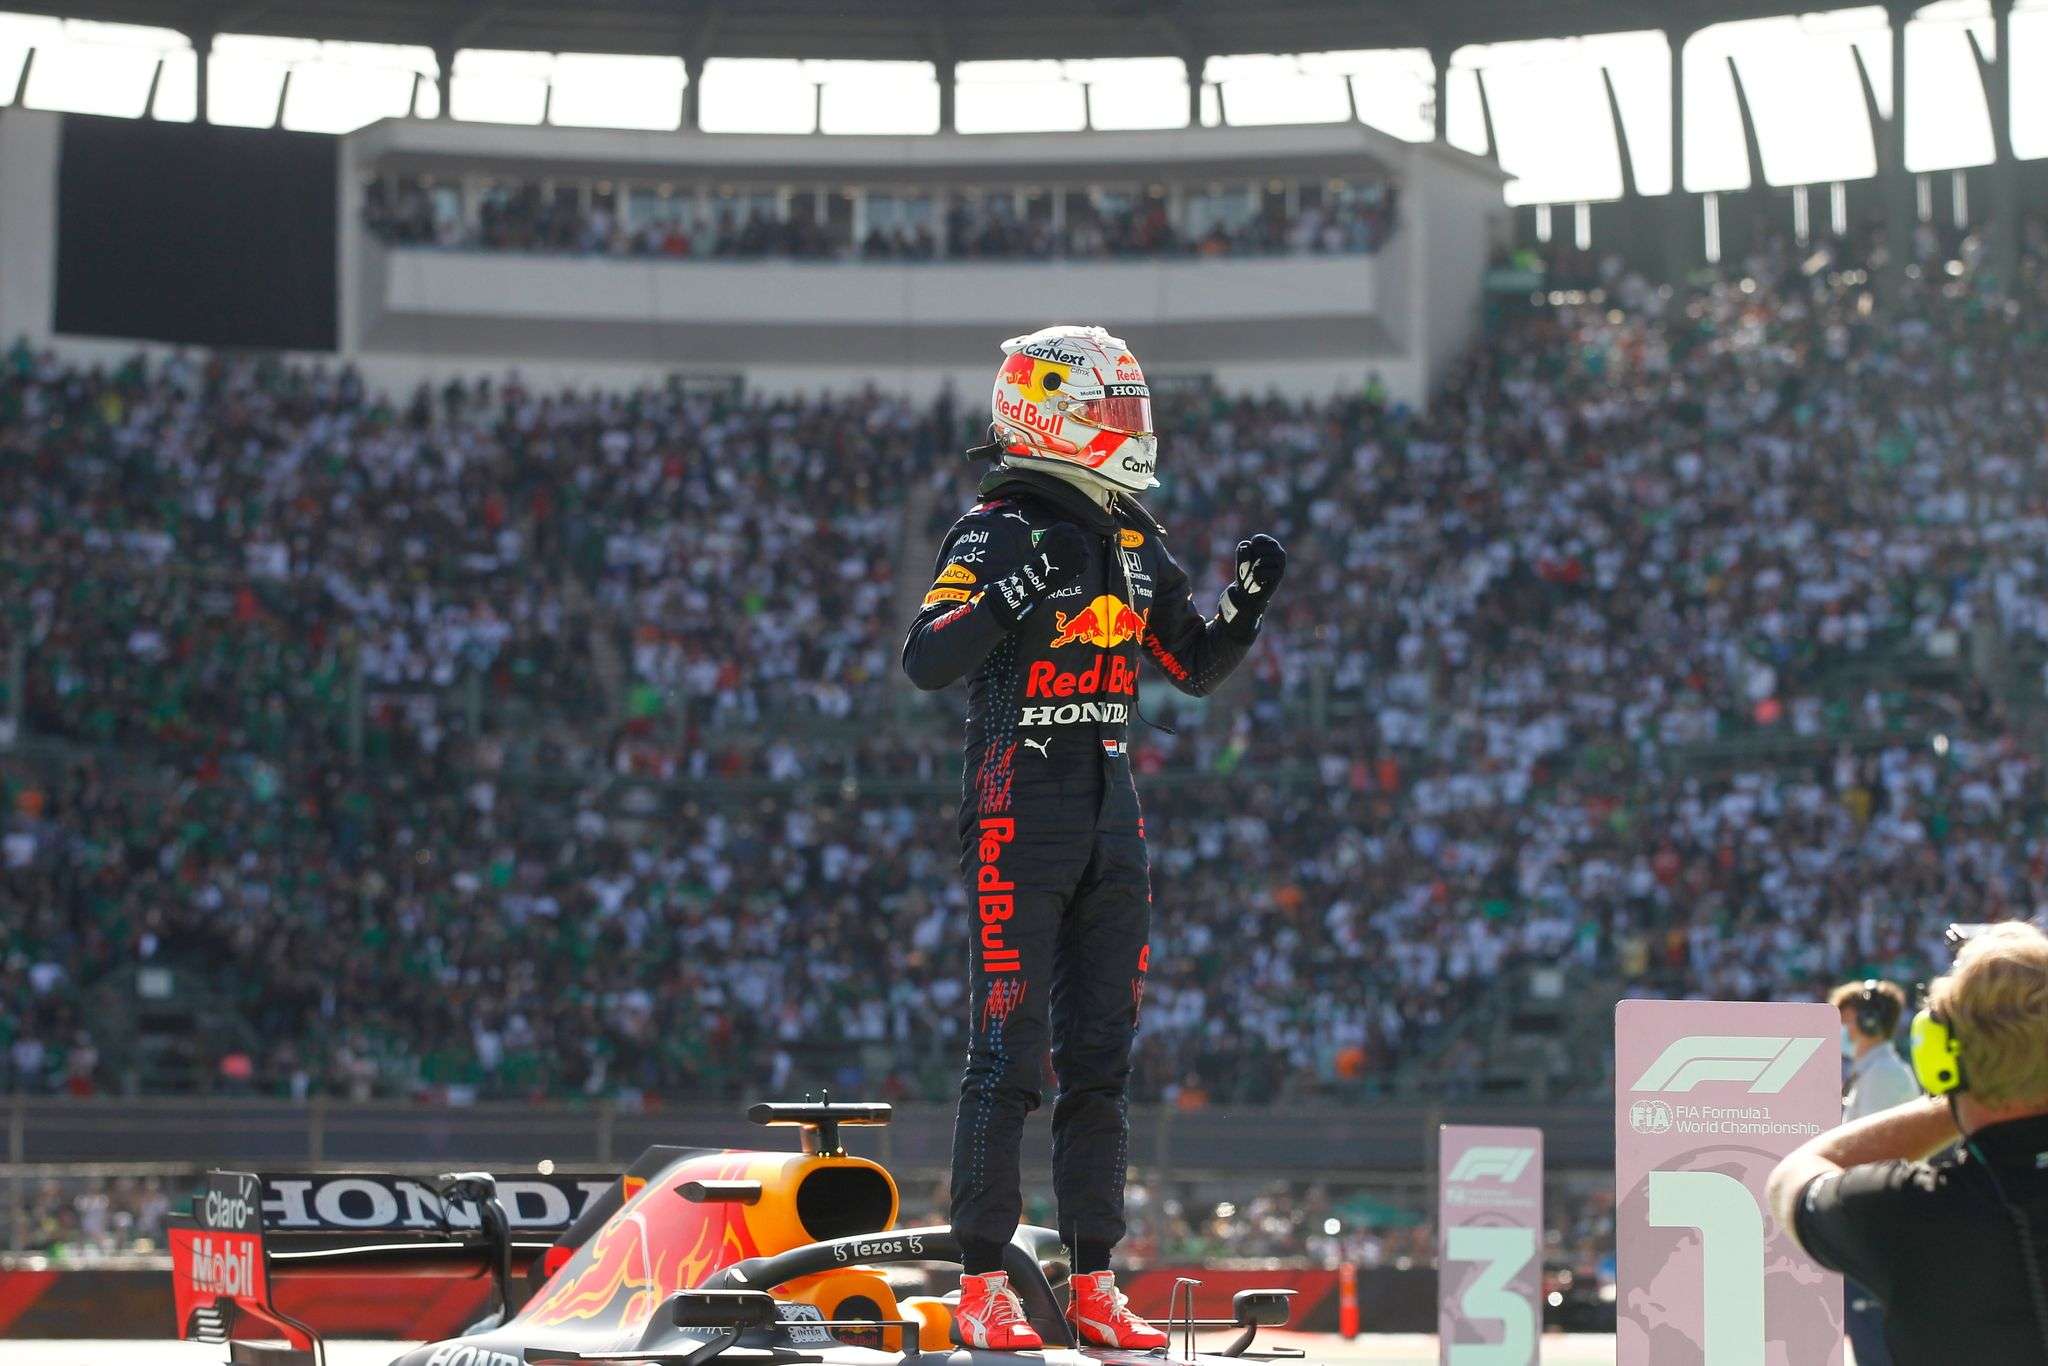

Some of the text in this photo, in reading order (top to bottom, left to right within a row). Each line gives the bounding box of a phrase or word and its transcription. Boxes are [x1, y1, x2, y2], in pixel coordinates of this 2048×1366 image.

[1025, 343, 1085, 366] CarNext
[1111, 385, 1150, 396] HOND
[1122, 455, 1154, 474] CarN
[941, 569, 969, 581] AUCH
[1130, 572, 1151, 581] ONDA
[1047, 586, 1082, 599] RACLE
[1676, 1106, 1699, 1119] FIA
[1676, 1121, 1820, 1136] World Championship
[851, 1240, 902, 1257] Tezos
[193, 1237, 254, 1296] Mobil
[1649, 1171, 1765, 1366] 1
[1447, 1227, 1536, 1366] 3
